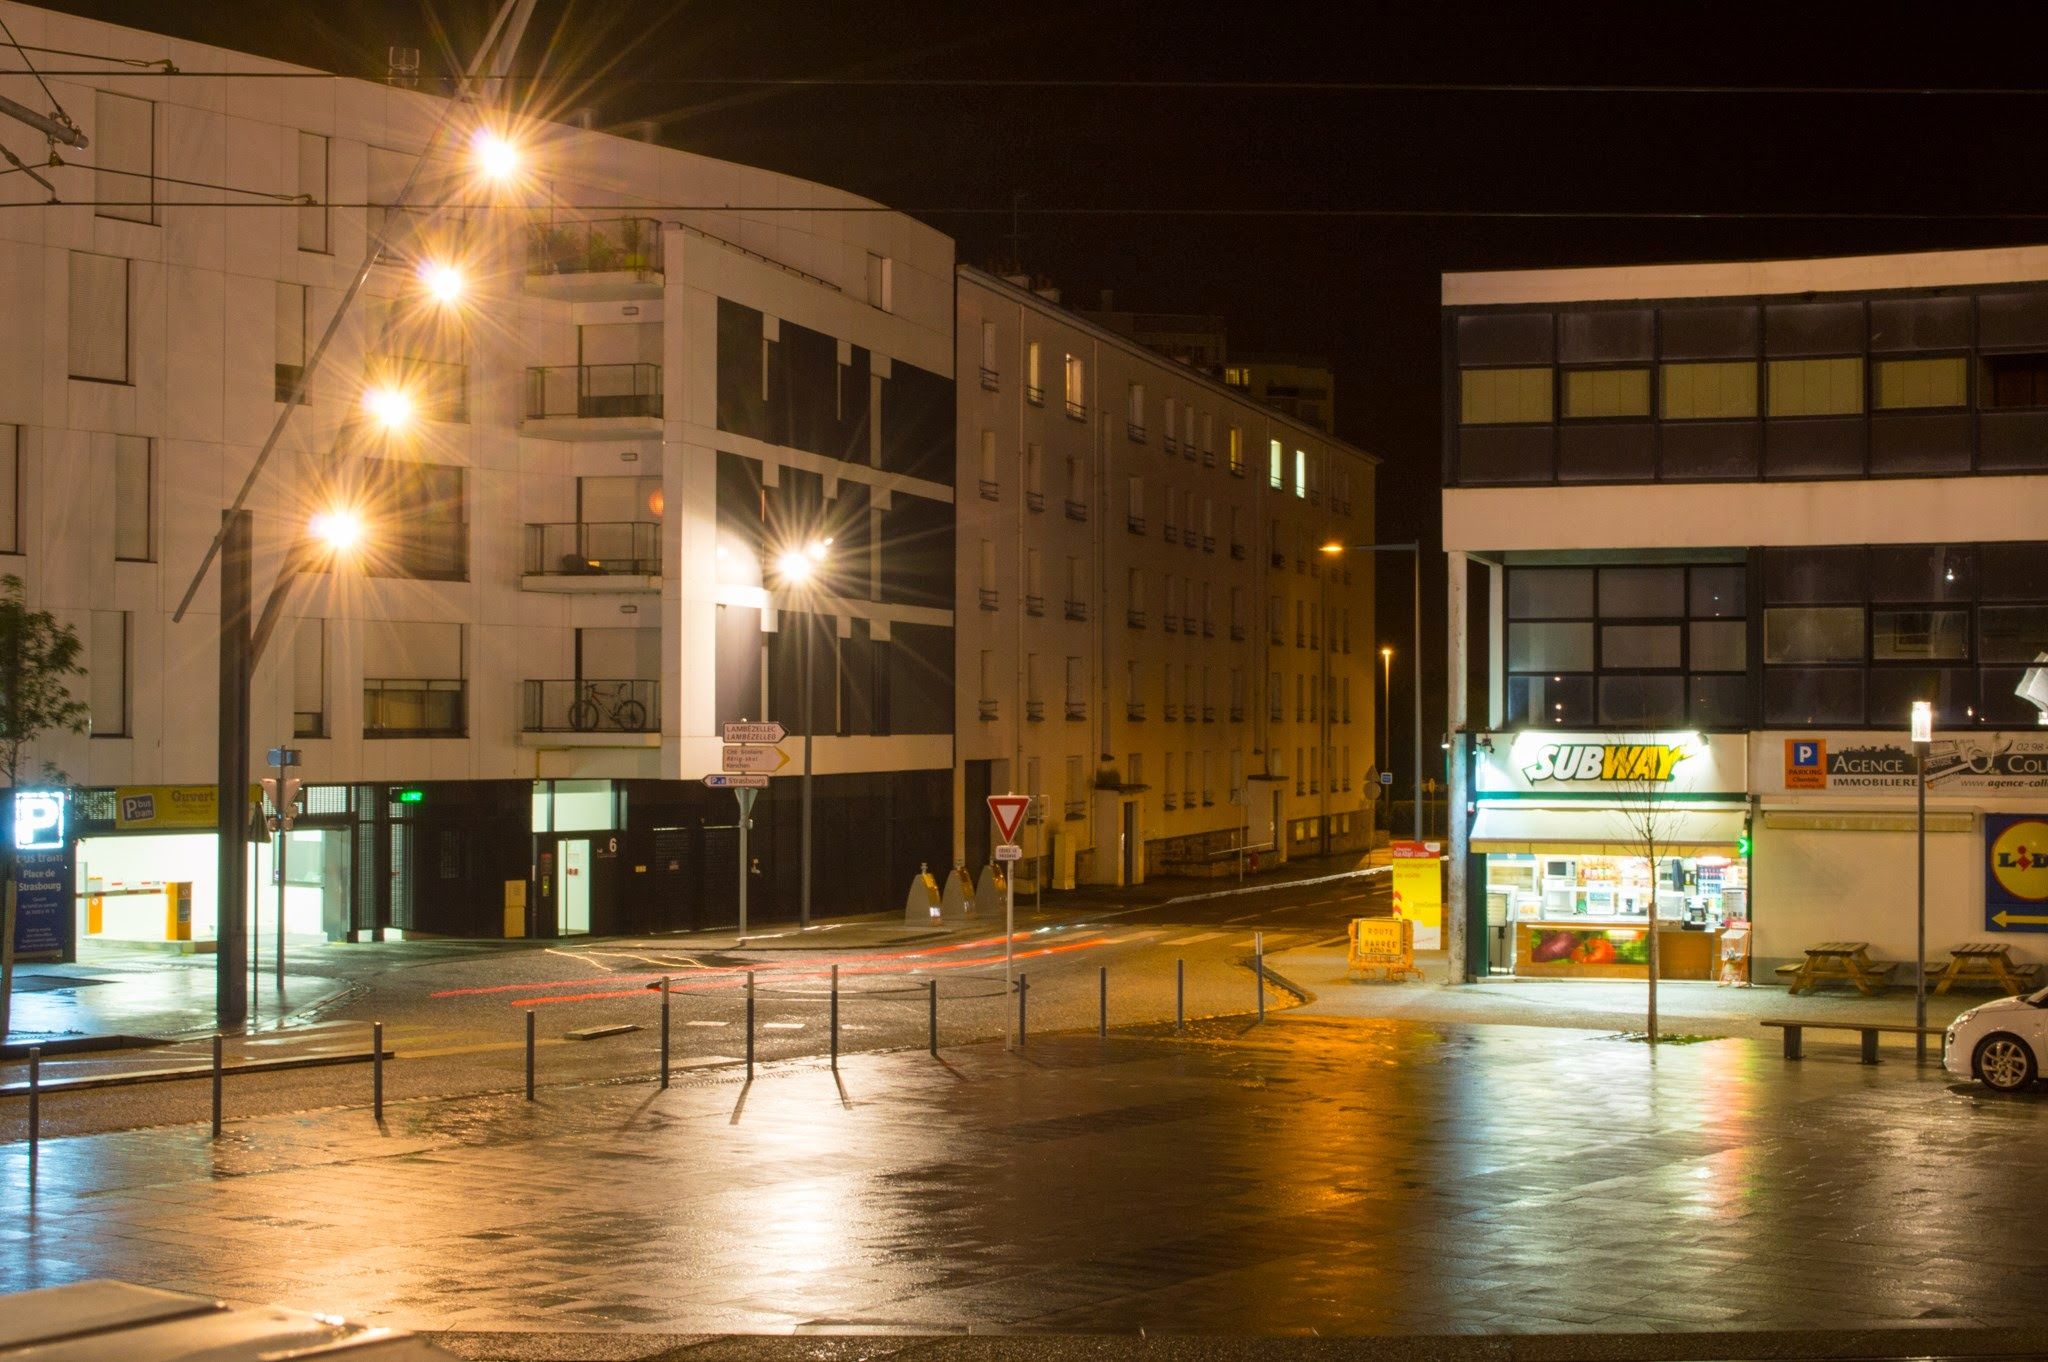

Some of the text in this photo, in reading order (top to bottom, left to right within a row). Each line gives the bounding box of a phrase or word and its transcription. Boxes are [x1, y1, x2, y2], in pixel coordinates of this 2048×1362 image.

[1800, 746, 1813, 763] P
[1522, 743, 1694, 786] SUBWAY
[1833, 755, 1904, 773] AGENCE
[2007, 755, 2048, 773] COL
[728, 777, 765, 785] Strasbourg
[1833, 778, 1917, 787] IMMOBILIERE
[1960, 778, 2048, 788] www.agence-coll
[609, 837, 617, 853] 6
[23, 869, 56, 878] Place de
[18, 882, 61, 891] Strasbourg
